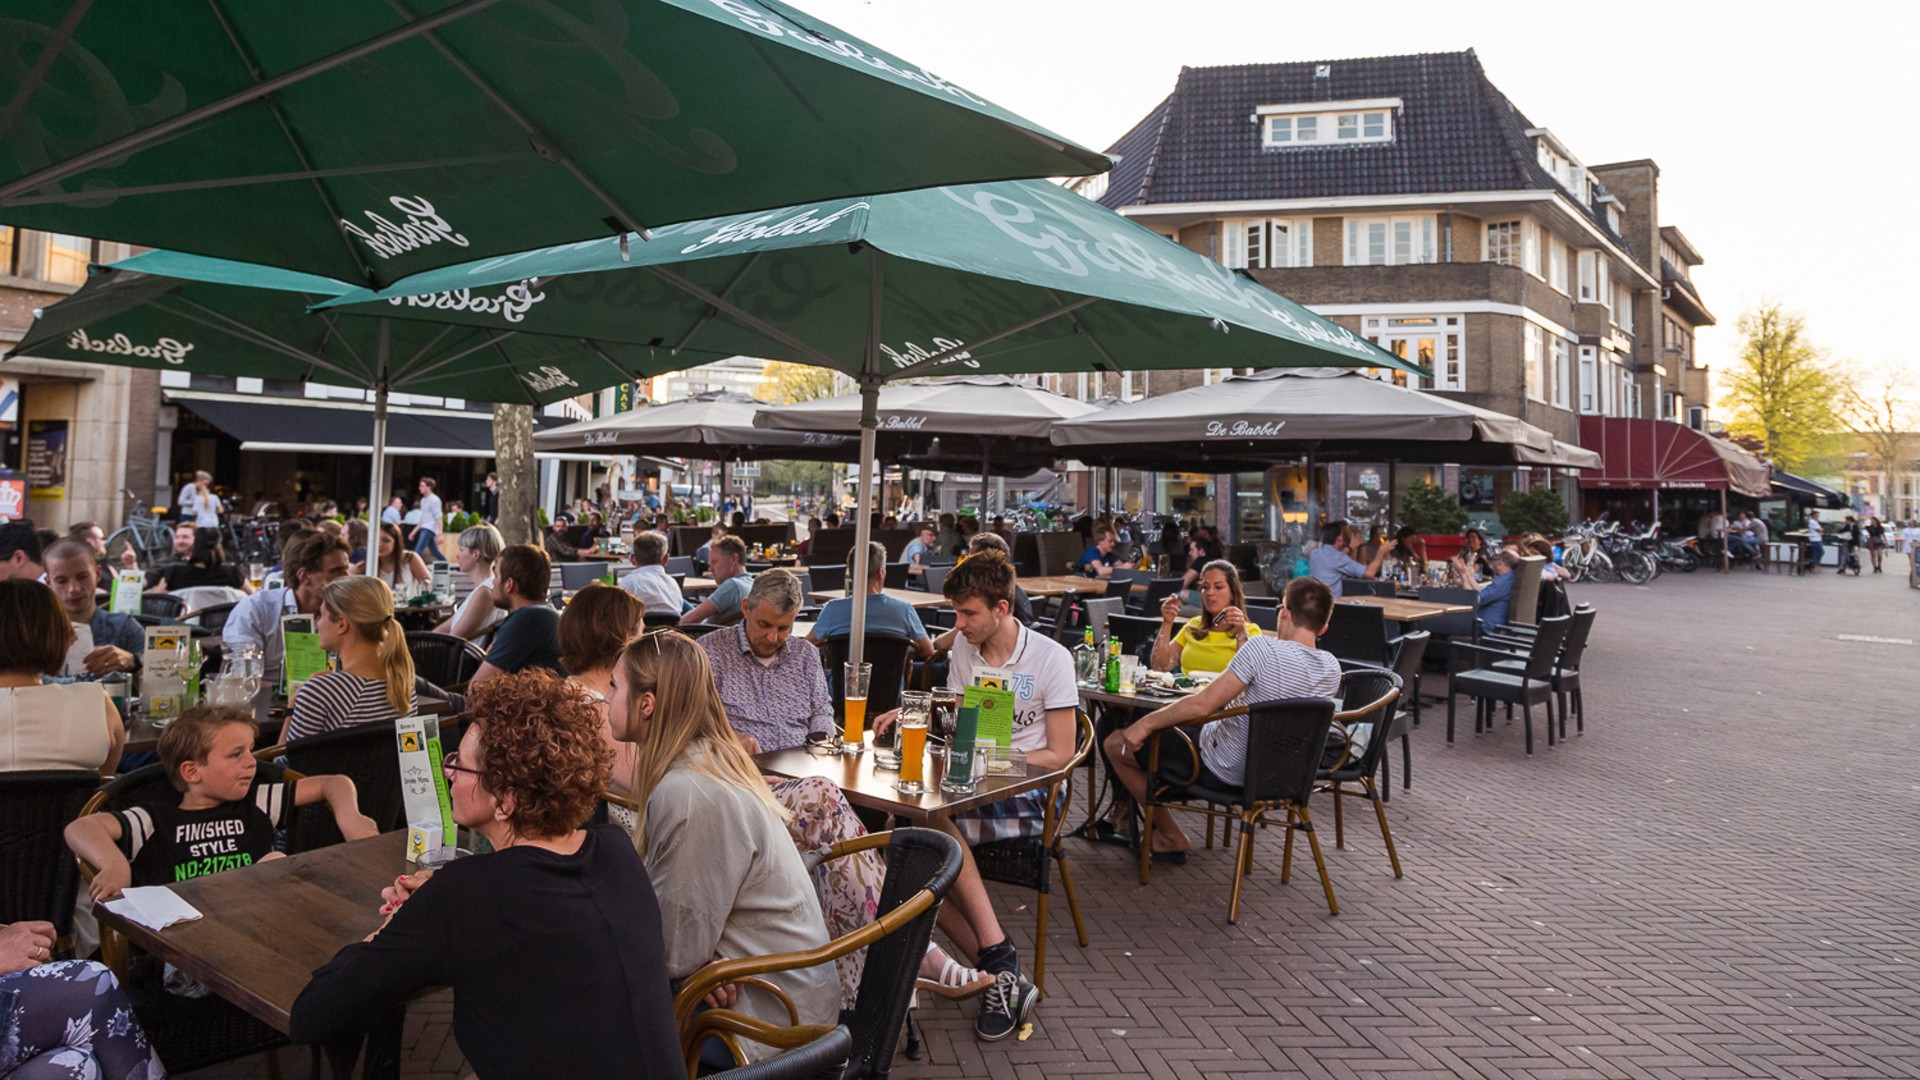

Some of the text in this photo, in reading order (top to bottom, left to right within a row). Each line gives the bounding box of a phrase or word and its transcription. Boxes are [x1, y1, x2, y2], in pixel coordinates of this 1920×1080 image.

[885, 415, 927, 429] Babbel
[1206, 420, 1286, 436] De Babbel
[1012, 673, 1034, 700] 75
[1013, 708, 1036, 726] LS
[176, 819, 245, 843] FINISHED
[189, 838, 238, 857] STYLE
